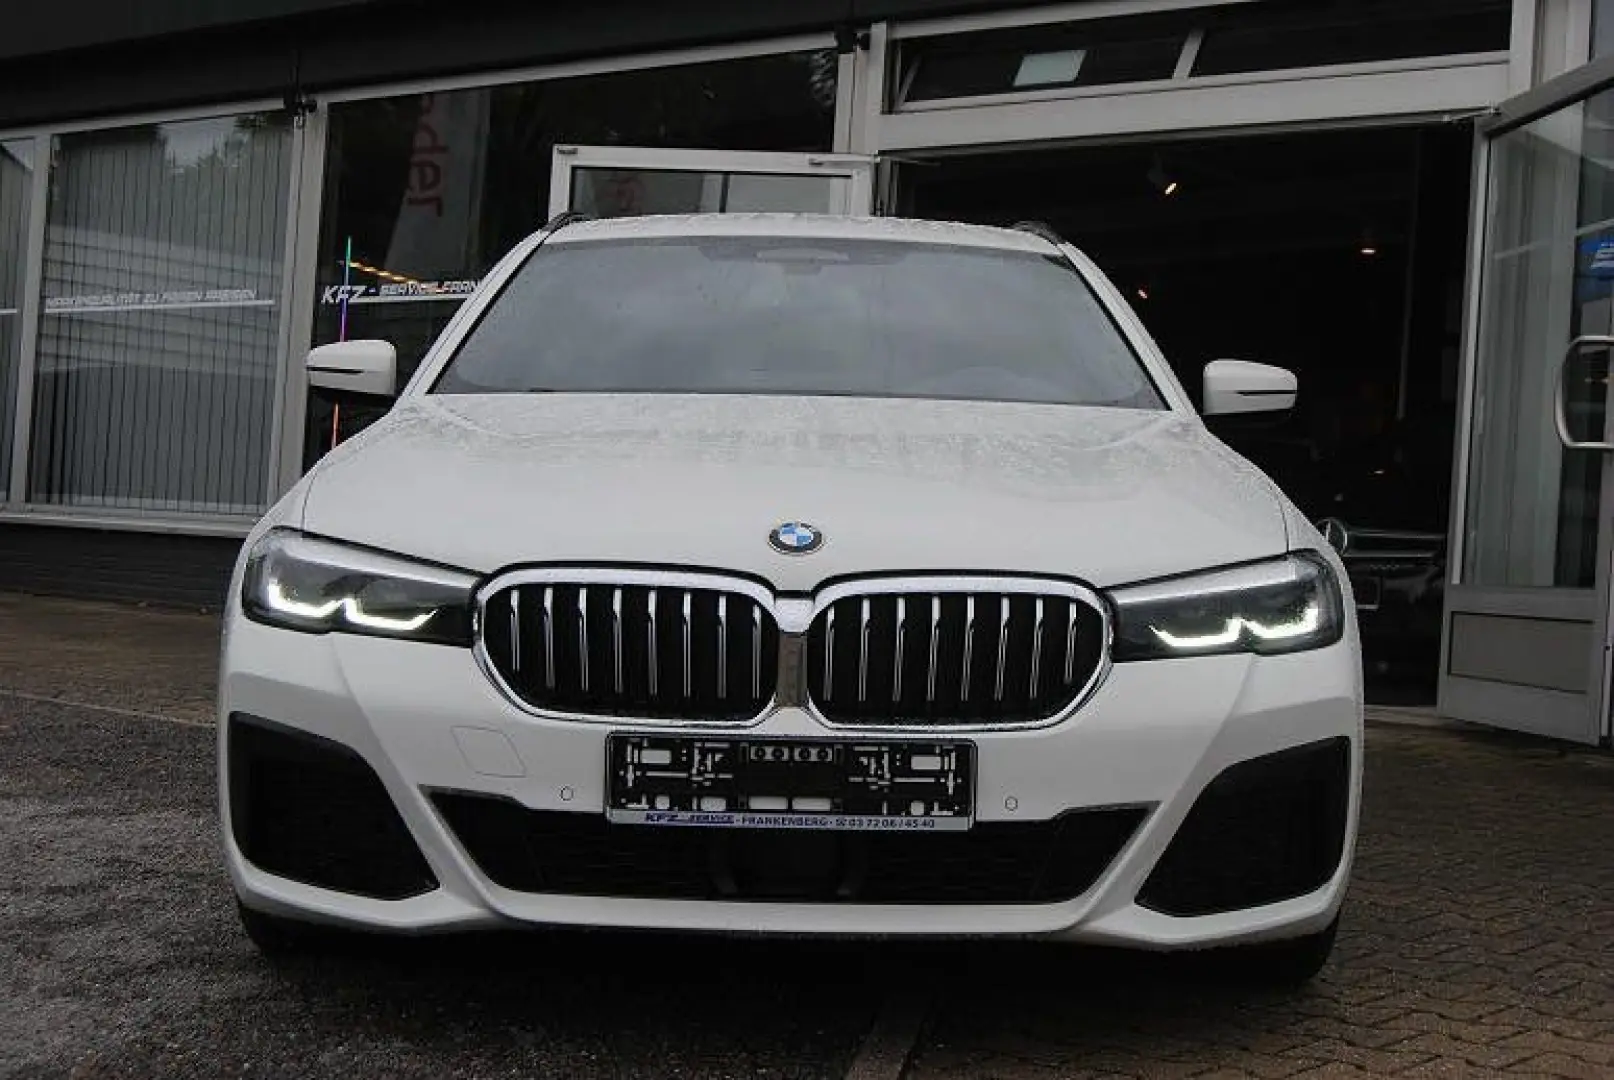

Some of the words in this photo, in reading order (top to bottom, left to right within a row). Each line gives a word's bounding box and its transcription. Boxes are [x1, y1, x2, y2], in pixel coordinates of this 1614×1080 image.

[321, 285, 368, 305] KFZ
[443, 280, 479, 295] FRAN
[742, 816, 829, 827] FRANKENBERG
